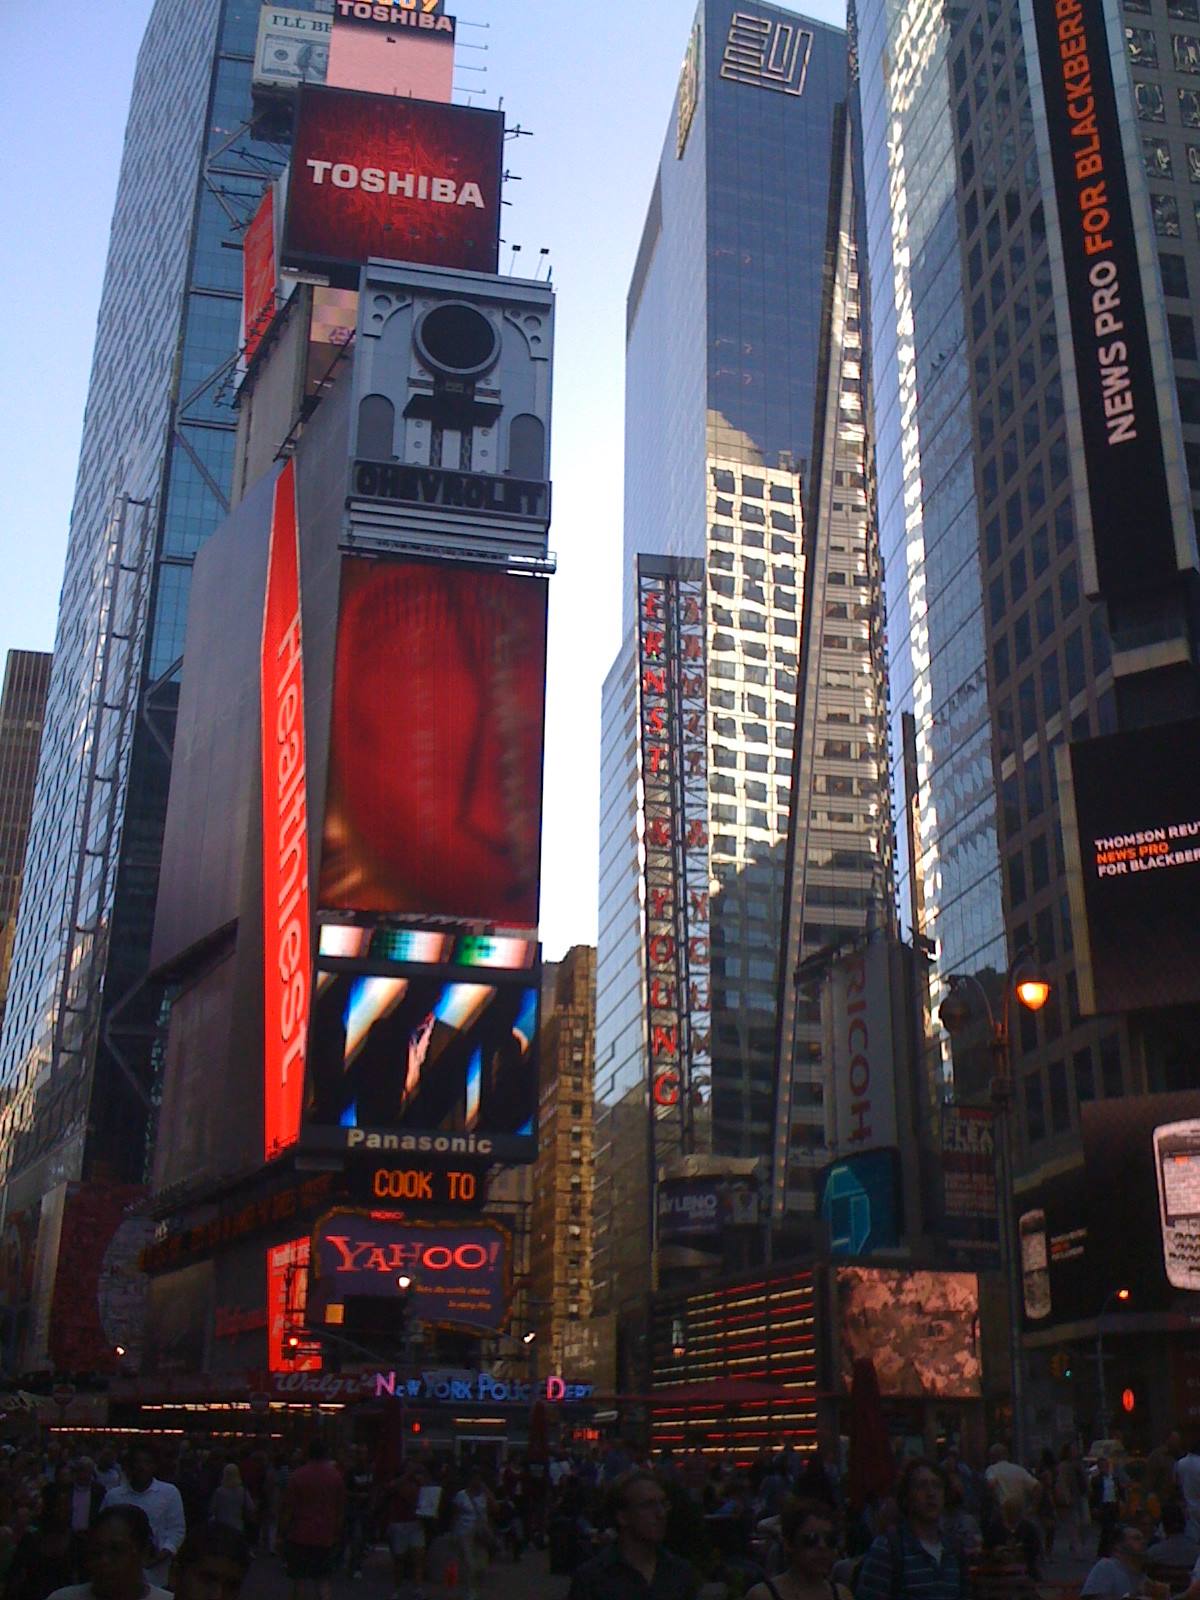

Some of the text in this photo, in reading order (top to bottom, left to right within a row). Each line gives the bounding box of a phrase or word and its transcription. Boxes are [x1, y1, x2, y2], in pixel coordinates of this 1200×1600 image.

[336, 0, 453, 32] TOSHIBA
[306, 159, 485, 208] TOSHIBA
[1078, 179, 1113, 257] FOR
[1089, 260, 1124, 338] PRO
[1100, 340, 1137, 446] NEWS
[643, 591, 667, 773] ERNST
[277, 611, 308, 1087] Healthiest
[1094, 828, 1166, 851] THOMSON
[1096, 842, 1169, 864] NEWS PRO
[1097, 862, 1128, 877] FOR
[651, 887, 680, 1106] YOUNG
[848, 957, 873, 1141] RICOH
[347, 1128, 493, 1154] Panasonic
[374, 1169, 476, 1200] COOK TO
[325, 1235, 499, 1272] YAHOO!
